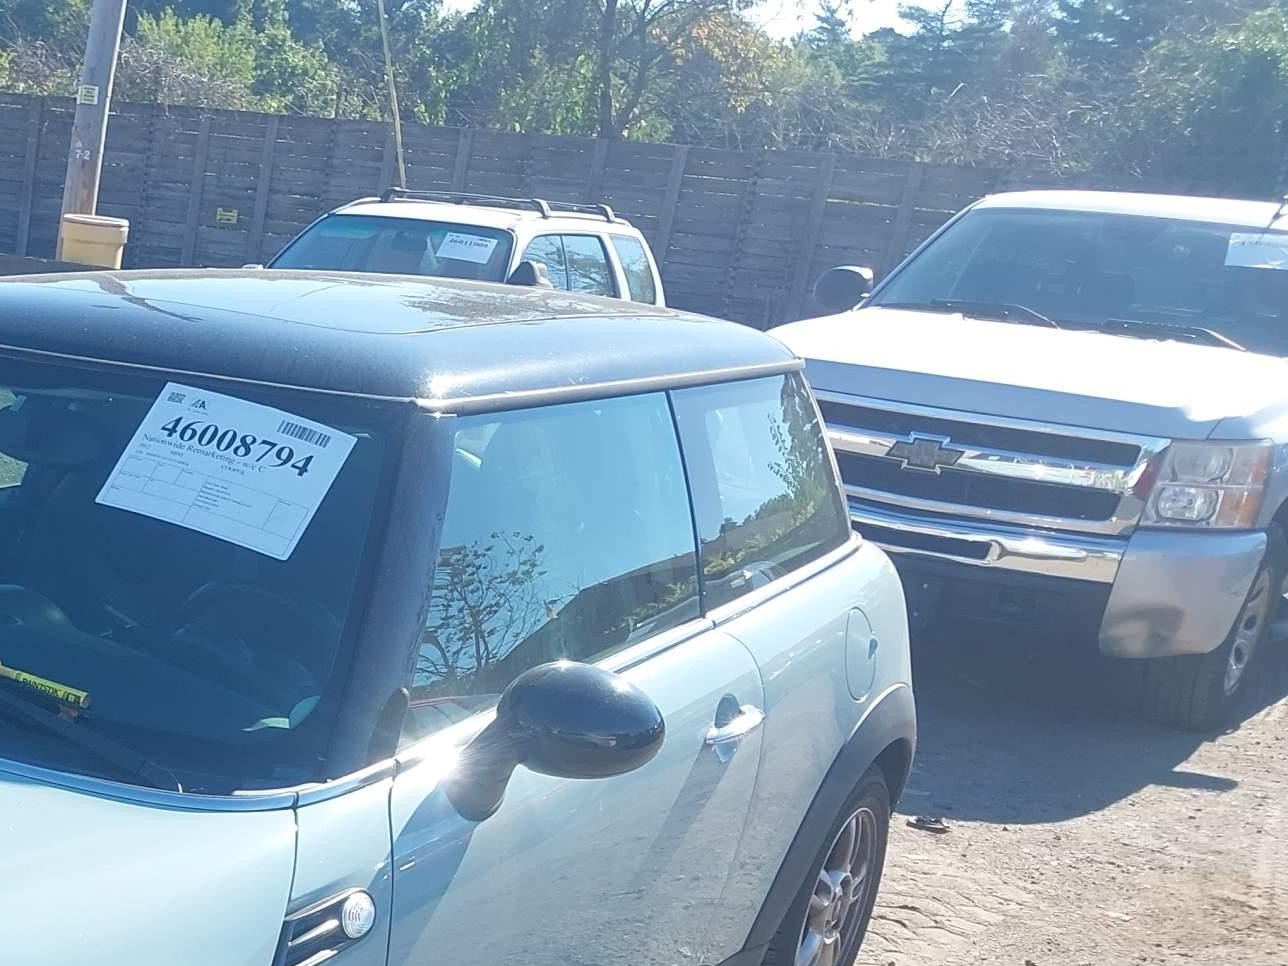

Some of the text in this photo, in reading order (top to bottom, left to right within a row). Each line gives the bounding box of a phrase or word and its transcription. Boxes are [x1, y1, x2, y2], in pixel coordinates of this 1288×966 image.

[143, 433, 186, 450] Nationwide
[186, 445, 235, 465] Remarketing
[160, 415, 315, 478] 46008794
